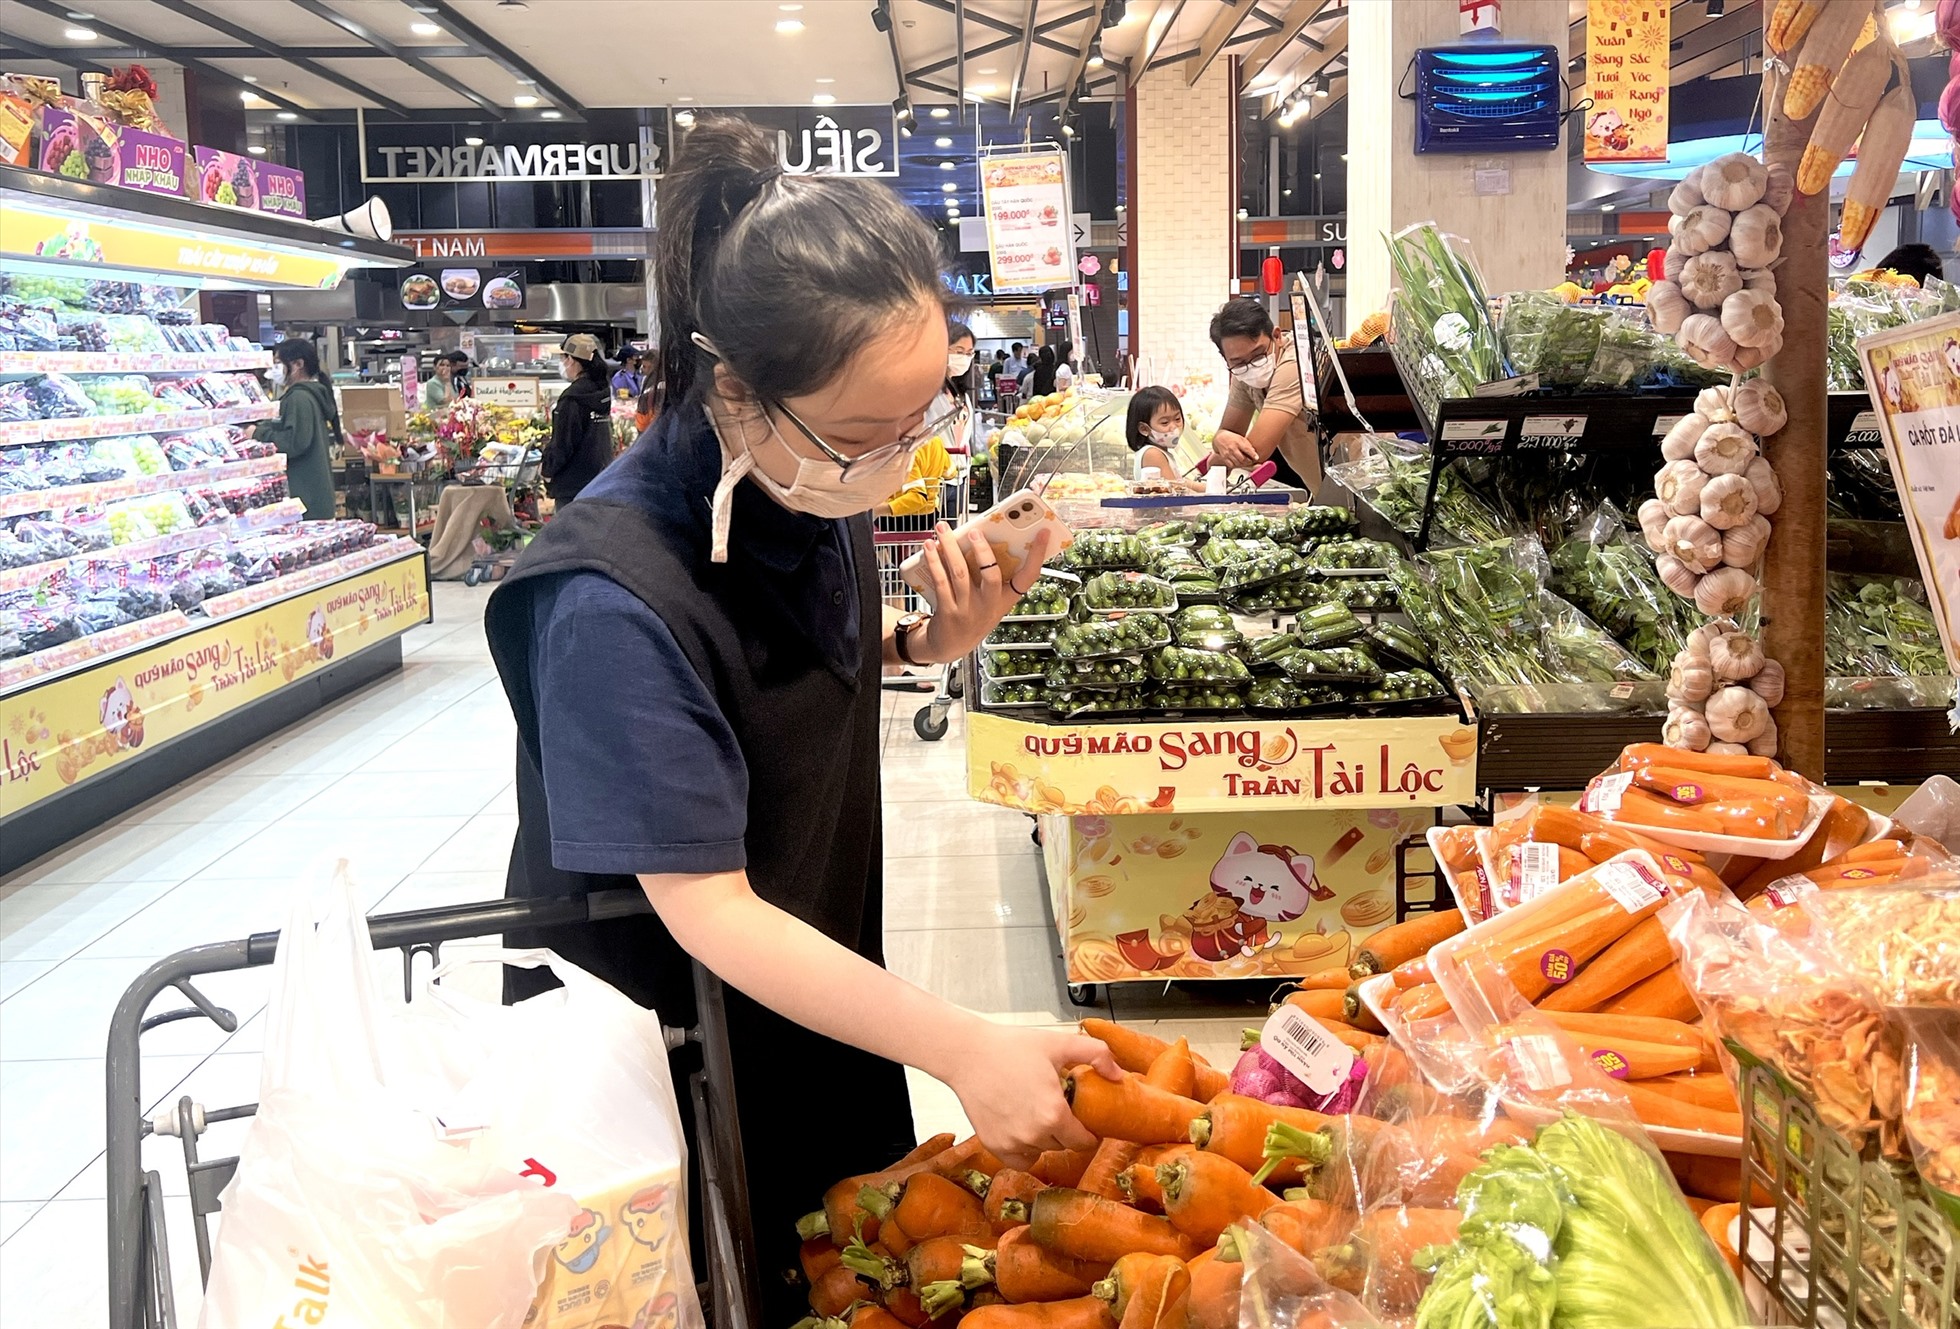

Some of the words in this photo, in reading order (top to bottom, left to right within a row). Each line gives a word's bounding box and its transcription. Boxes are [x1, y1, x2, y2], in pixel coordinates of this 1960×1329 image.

[1595, 36, 1625, 46] Xuân
[1593, 53, 1623, 68] Sang
[1594, 71, 1619, 82] Tươi
[1630, 71, 1652, 82] Vóc
[1629, 89, 1660, 104] Rạng
[136, 145, 172, 172] NHO
[125, 167, 153, 188] NHẬP
[267, 174, 296, 198] NHO
[432, 237, 486, 257] NAM
[1908, 424, 1921, 446] CÀ
[1919, 419, 1937, 446] RỐT
[1938, 419, 1956, 444] ĐÀ
[357, 582, 381, 612] Sang
[134, 664, 160, 689] QUÝ
[160, 657, 185, 679] MÃO
[185, 643, 221, 681] Sang
[3, 738, 42, 782] Lộc
[1024, 730, 1084, 758] QUÝ
[1087, 731, 1153, 756] MÃO
[1158, 729, 1262, 772] Sang
[1223, 772, 1302, 798] TRÀN
[1302, 742, 1366, 801] Tài
[1378, 743, 1446, 801] Lộc
